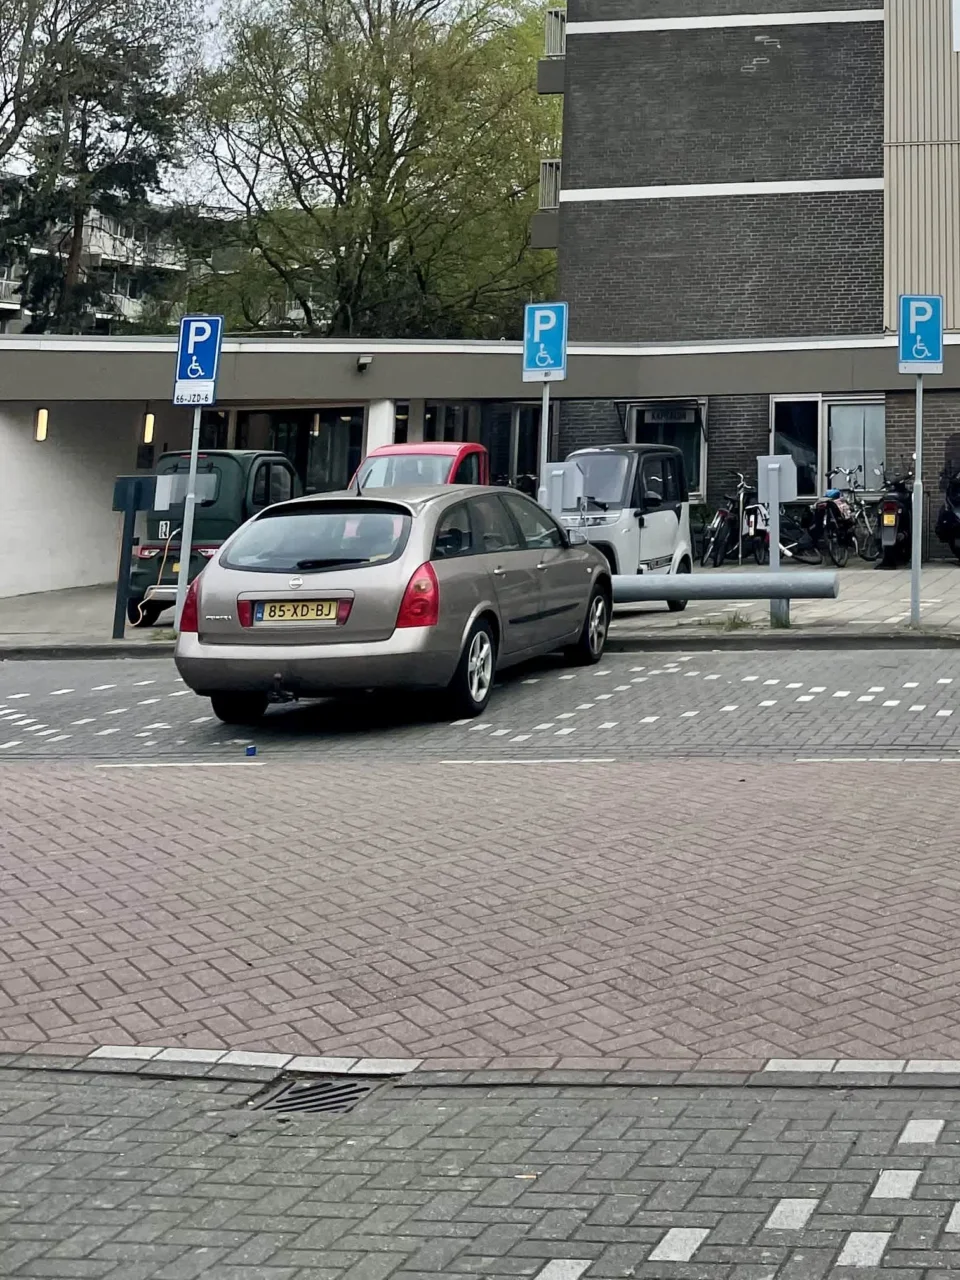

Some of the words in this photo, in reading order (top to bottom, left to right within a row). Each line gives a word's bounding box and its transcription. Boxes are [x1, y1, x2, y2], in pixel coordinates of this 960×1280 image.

[533, 309, 556, 343] P
[910, 301, 933, 334] P
[187, 321, 212, 354] P
[268, 603, 332, 618] 85-XD-BJ
